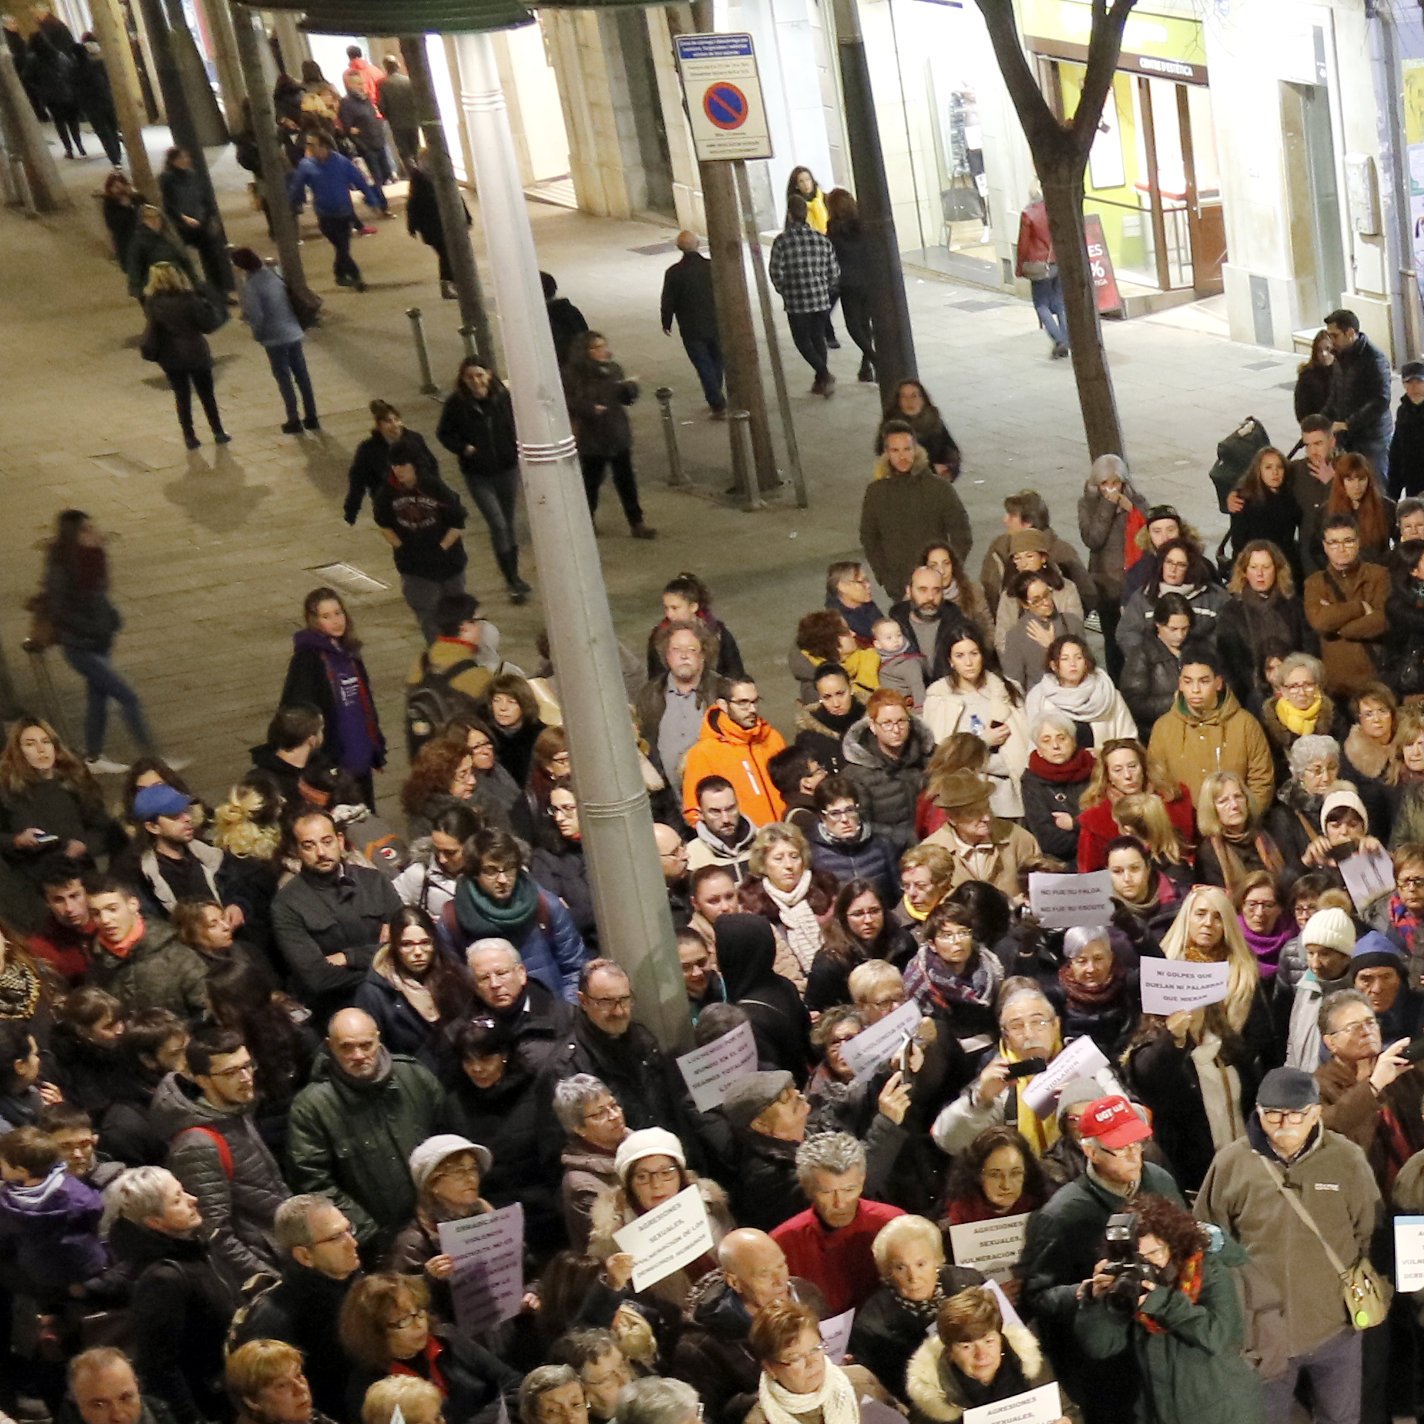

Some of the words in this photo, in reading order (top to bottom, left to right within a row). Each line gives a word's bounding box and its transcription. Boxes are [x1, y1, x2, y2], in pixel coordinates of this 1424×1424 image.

[1166, 972, 1196, 980] GOLPES
[638, 1202, 682, 1232] AGRESIONES
[648, 1218, 684, 1244] SEXUALES,
[682, 1230, 692, 1240] DE
[692, 1220, 704, 1232] LOS
[974, 1220, 1024, 1236] AGRESIONES
[980, 1234, 1022, 1248] SEXUALES,
[960, 1250, 1016, 1266] VULNERACIÓN
[988, 1396, 1038, 1416] AGRESIONES
